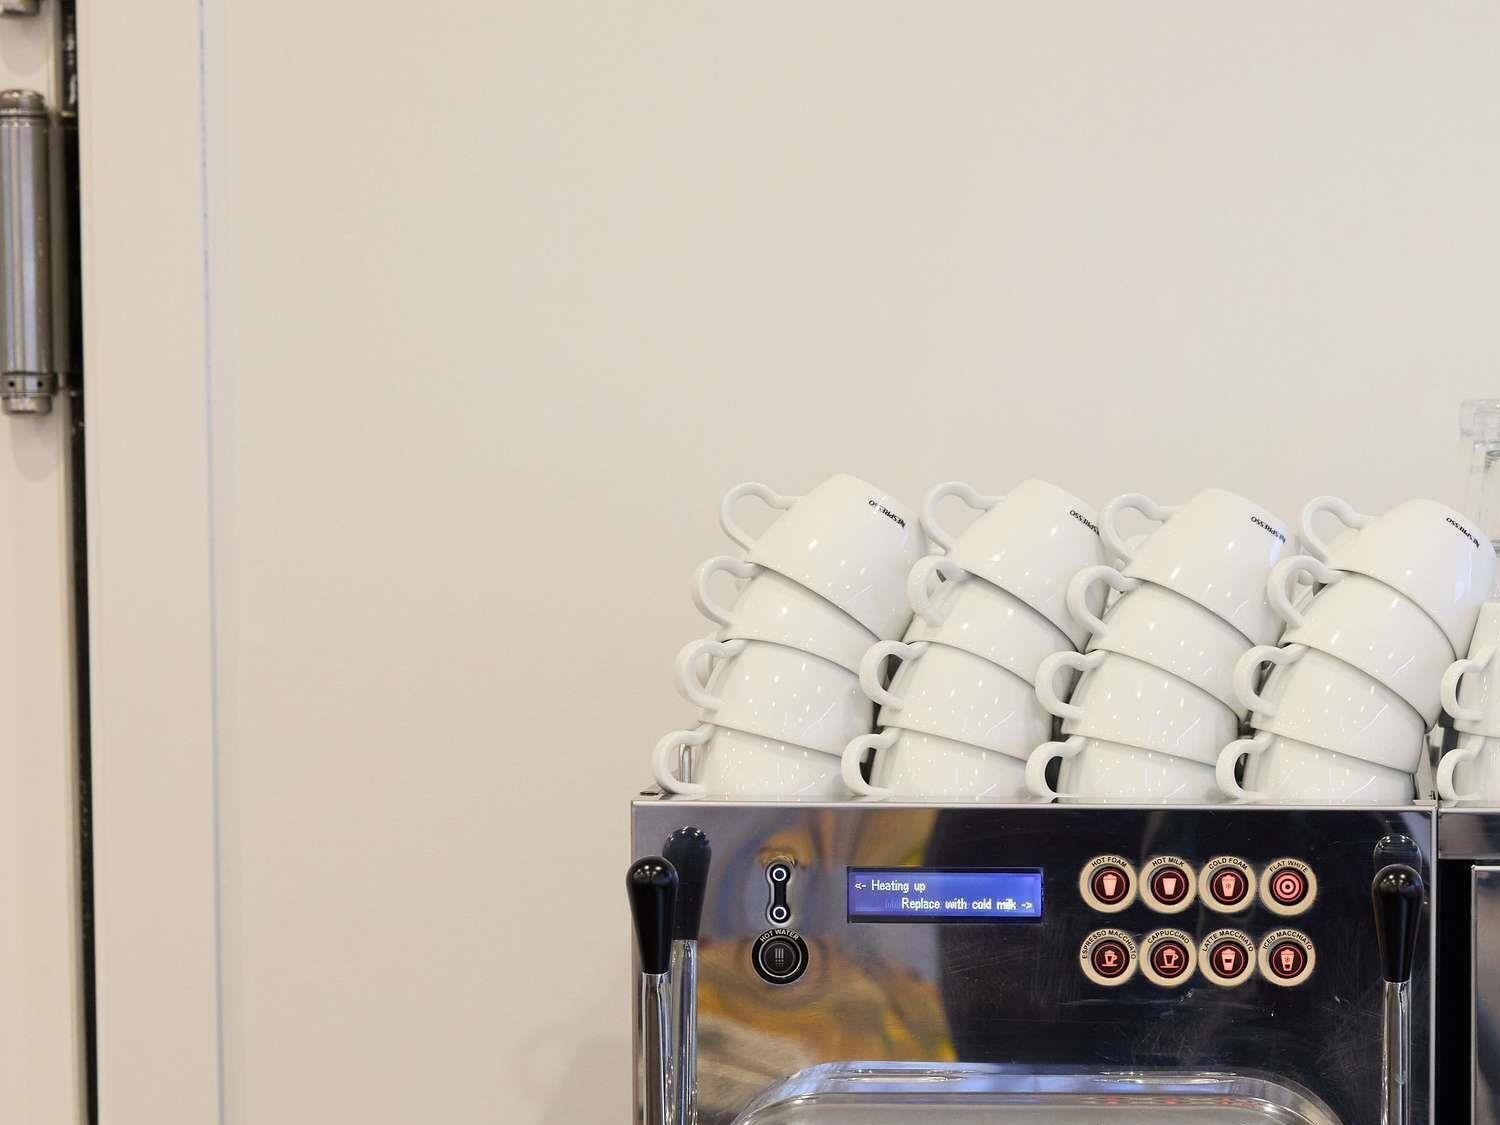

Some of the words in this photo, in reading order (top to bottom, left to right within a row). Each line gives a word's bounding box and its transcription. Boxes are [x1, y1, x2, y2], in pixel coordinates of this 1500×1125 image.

[1091, 857, 1107, 868] HOT
[1107, 856, 1128, 868] FOAM
[1151, 857, 1167, 867] HOT
[1168, 857, 1185, 868] MILK
[1208, 857, 1228, 870] COLD
[1228, 857, 1248, 871] FOAM
[1269, 860, 1286, 873] FLAT
[1287, 860, 1308, 873] WHITE
[871, 880, 909, 894] Heating
[914, 882, 926, 892] up
[901, 897, 940, 911] Replace
[945, 897, 967, 910] with
[972, 898, 992, 910] cold
[997, 898, 1017, 910] milk
[760, 930, 773, 942] HOT
[774, 928, 800, 941] WATER
[1147, 930, 1190, 944] CAPPUCCINO
[1202, 931, 1218, 952] LATTE
[1218, 930, 1254, 952] MACCHIATO
[1262, 932, 1276, 950] ICED
[1276, 930, 1313, 951] MACCHIATO
[1081, 929, 1107, 959] ESPRESSO
[1108, 929, 1137, 960] MACCHIATO
